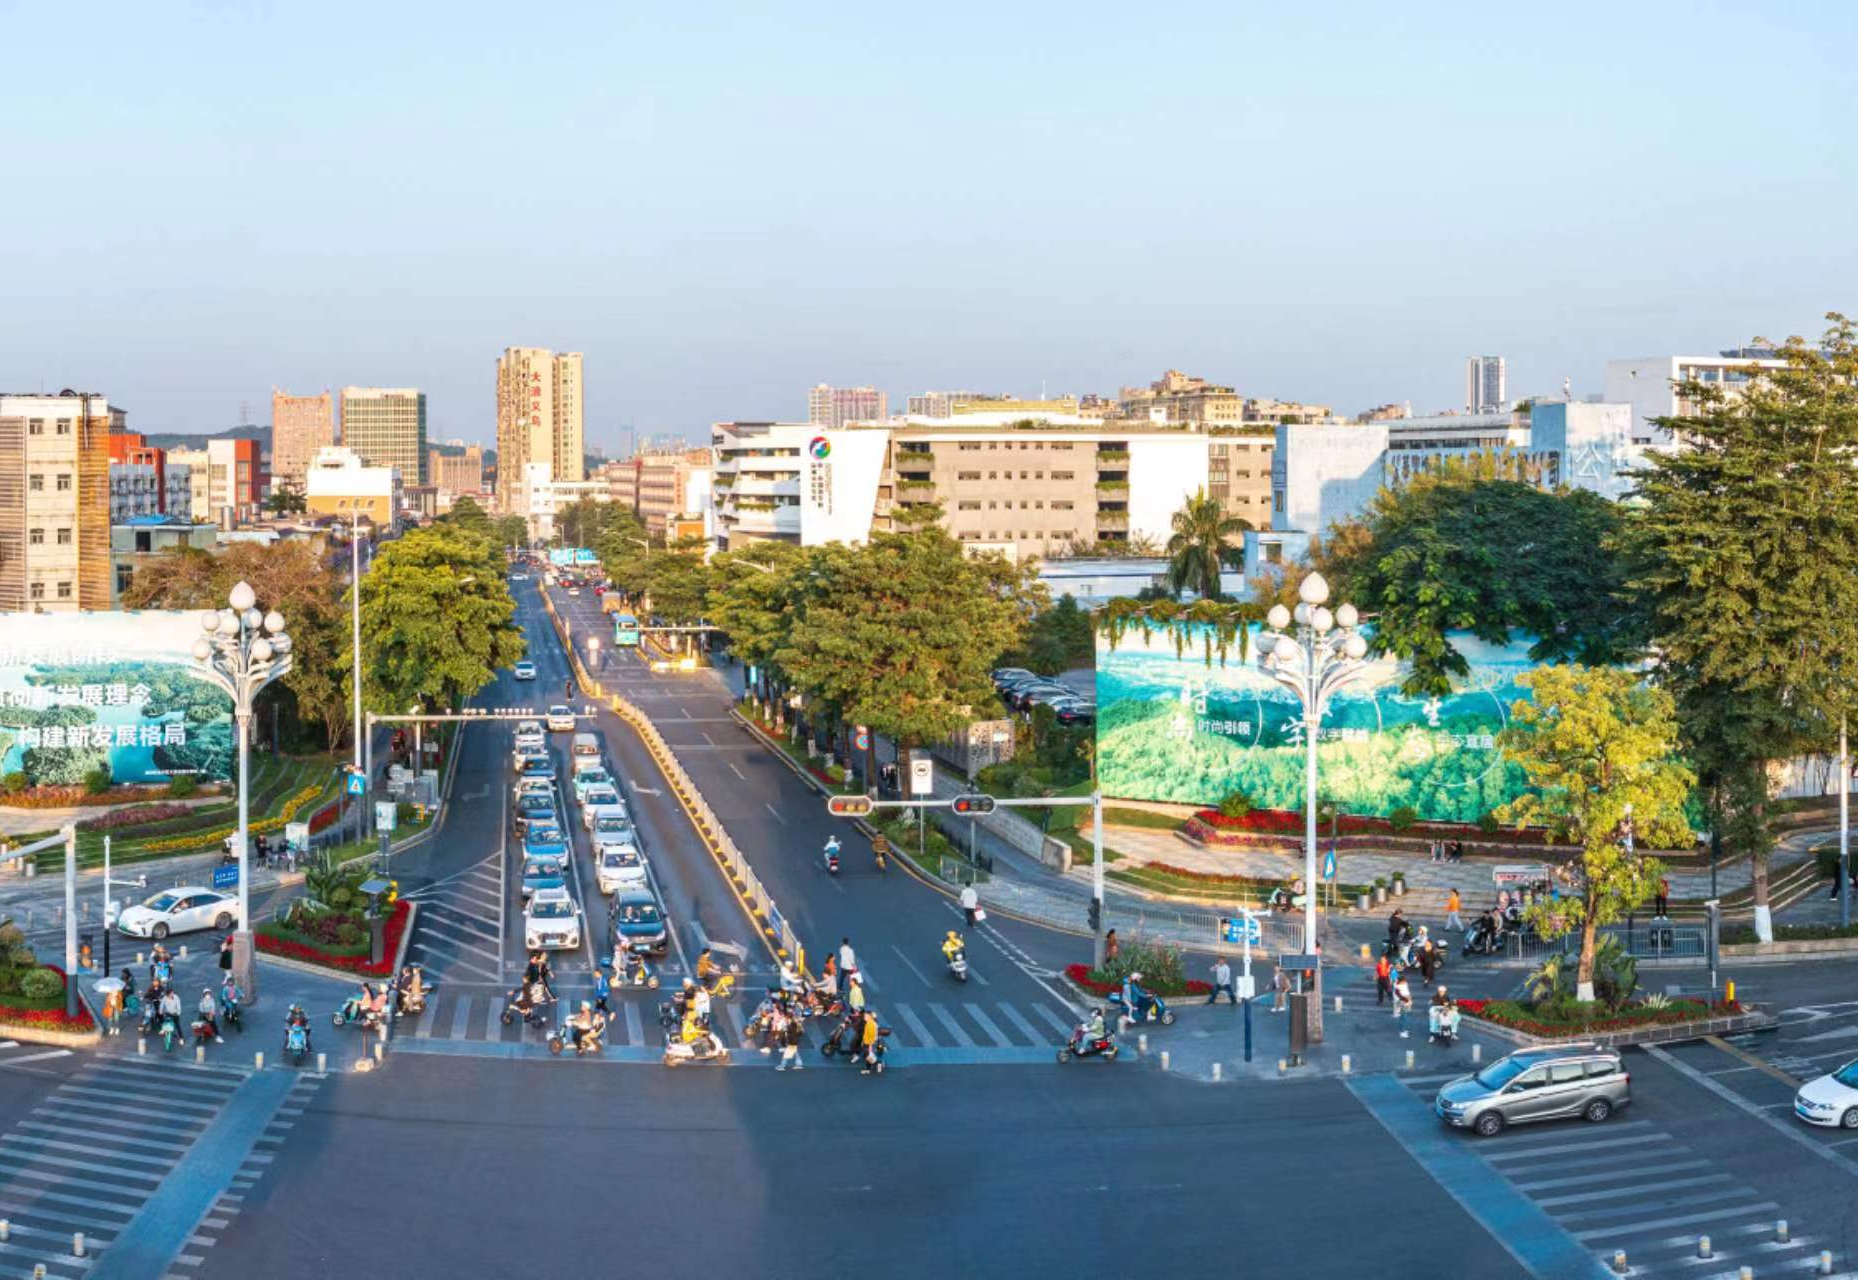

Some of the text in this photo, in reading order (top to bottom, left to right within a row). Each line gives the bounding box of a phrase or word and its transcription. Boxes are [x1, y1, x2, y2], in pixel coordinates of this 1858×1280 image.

[17, 724, 186, 748] 构建新发展格局
